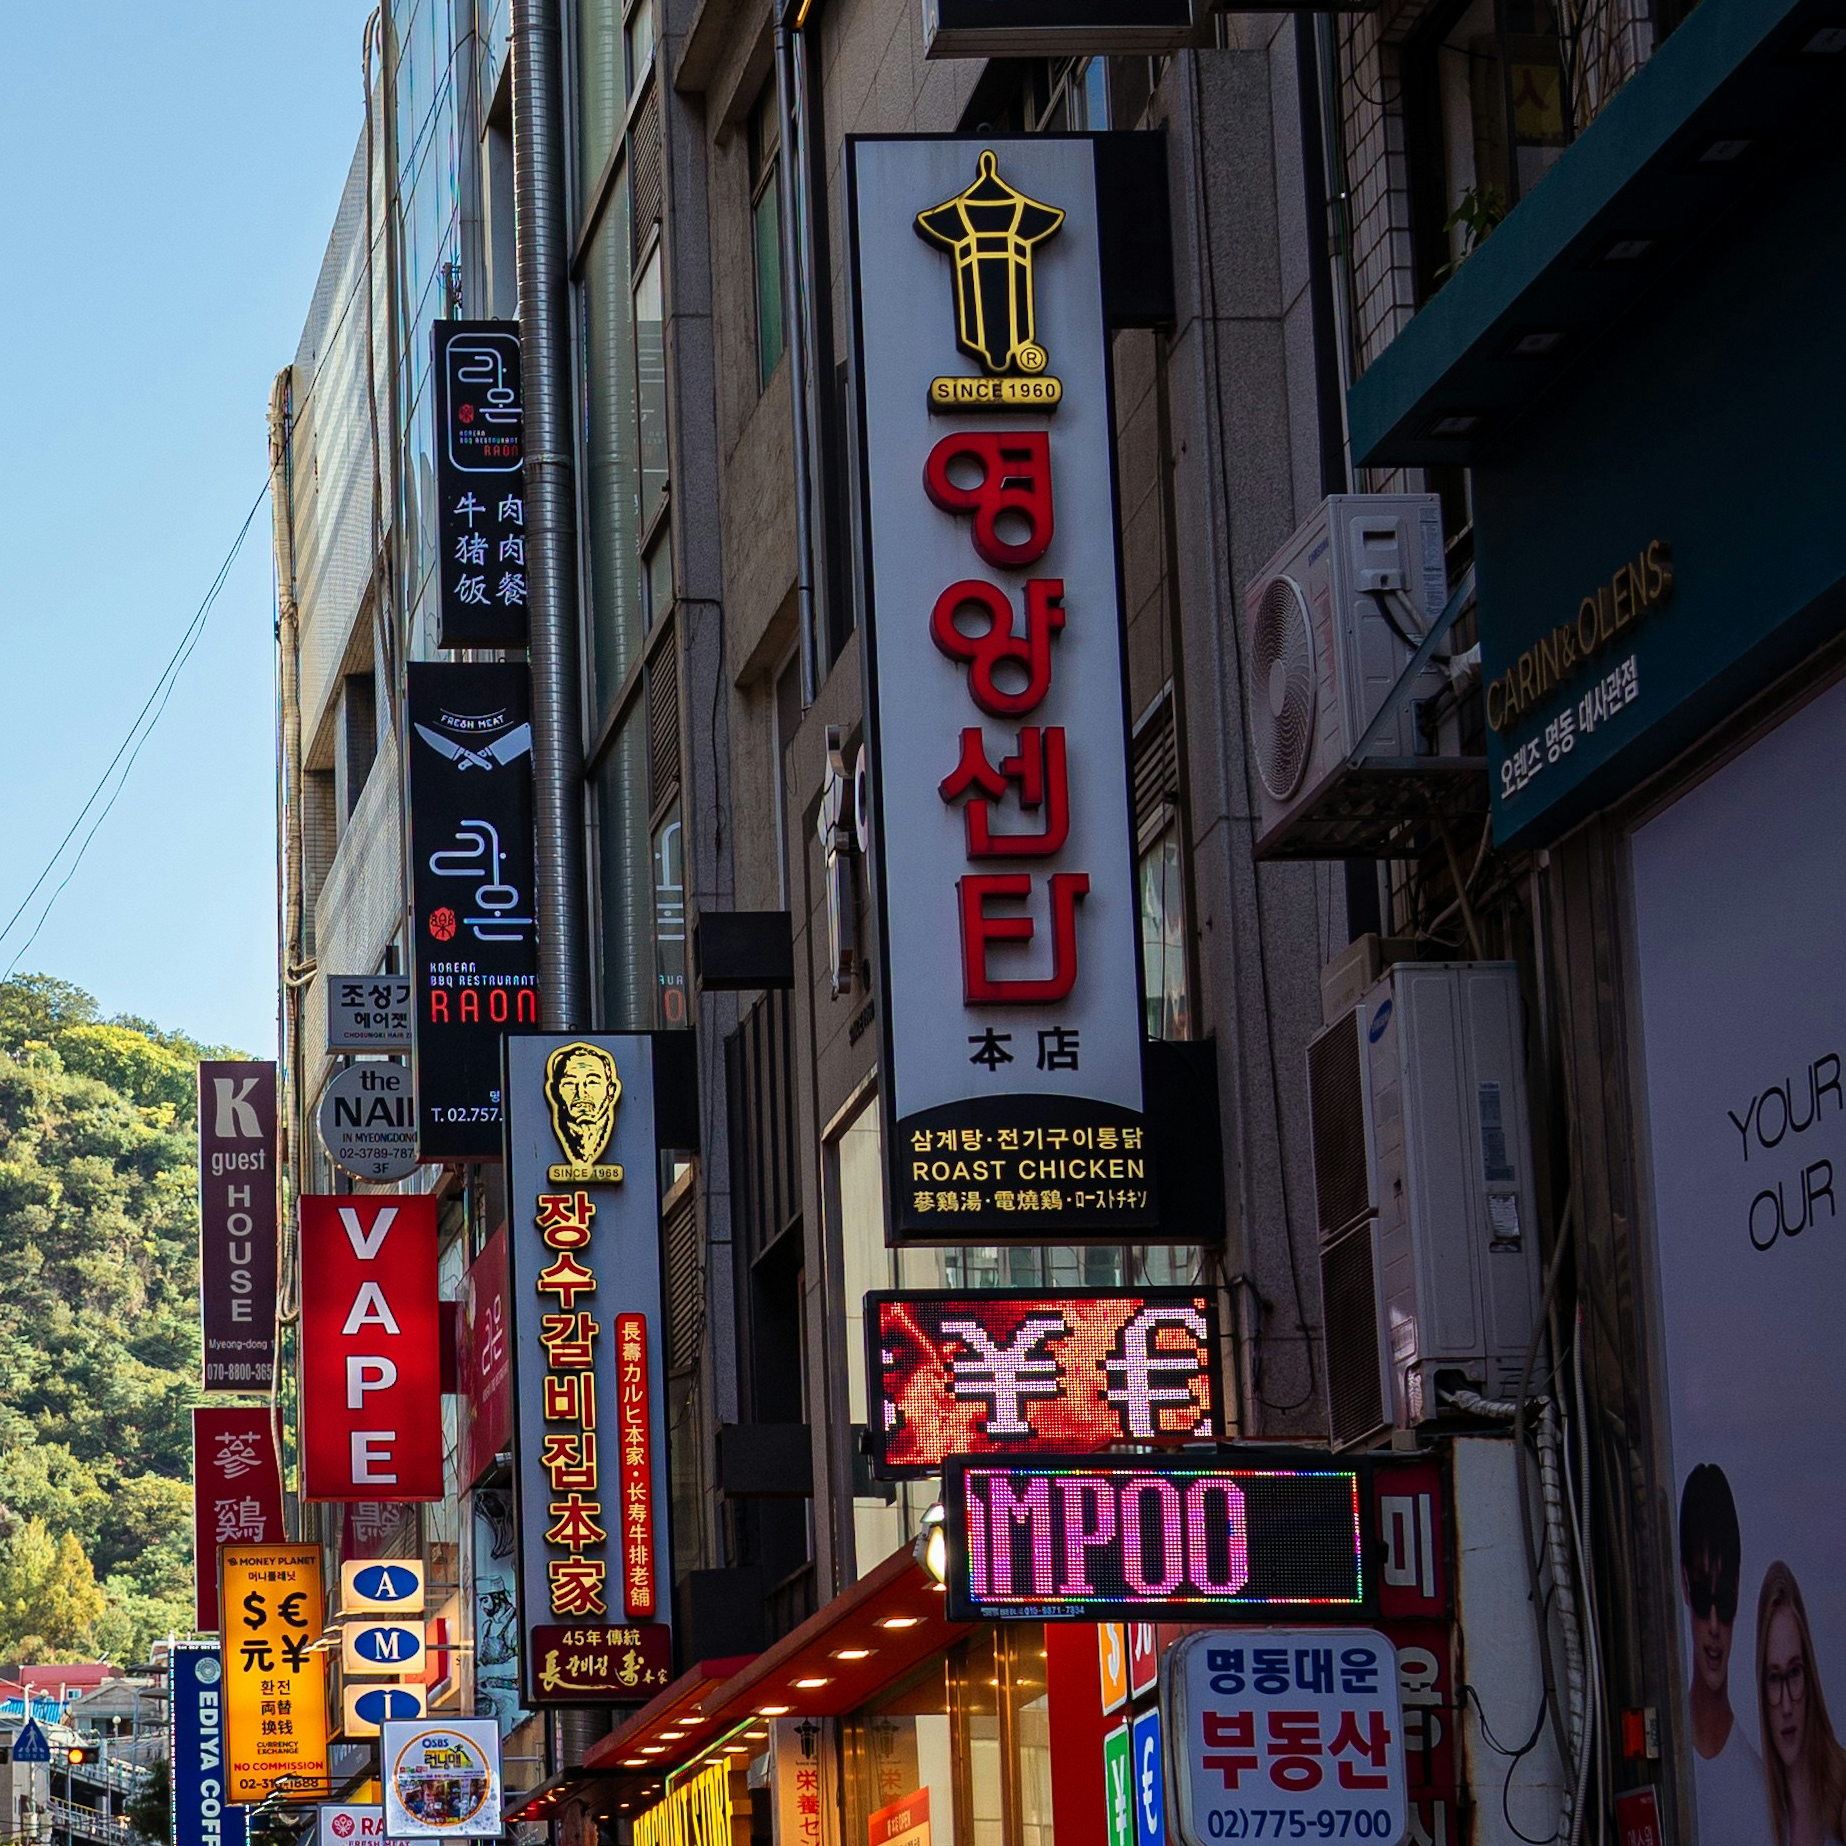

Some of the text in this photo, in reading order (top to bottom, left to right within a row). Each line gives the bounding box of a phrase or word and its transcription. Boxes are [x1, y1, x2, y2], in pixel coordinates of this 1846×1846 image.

[937, 382, 1059, 399] SINCE 1960
[478, 714, 505, 730] MEAT
[1500, 655, 1639, 800] 오렌즈 명동 대사관점
[430, 962, 477, 974] KOREAN
[430, 975, 535, 987] BBQ RESTAURANT
[430, 988, 537, 1025] RAON
[969, 1026, 1082, 1073] 本店
[360, 1070, 400, 1091] the
[213, 1077, 264, 1139] K
[1728, 1053, 1844, 1162] YOUR
[342, 1133, 353, 1143] IN
[212, 1150, 266, 1180] guest
[372, 1162, 390, 1174] 3F
[553, 1167, 621, 1179] SINCE 1968
[912, 1158, 1145, 1180] ROAST CHICKEN
[1749, 1159, 1836, 1252] OUR
[227, 1185, 254, 1323] HOUSE
[208, 1338, 268, 1353] Myeong-dong
[338, 1207, 401, 1485] VAPE
[536, 1190, 607, 1620] 장수갈비집本家
[239, 1555, 316, 1566] MONEY PLANET
[561, 1629, 602, 1649] 45年
[1208, 1647, 1378, 1694] 명동대운
[260, 1680, 291, 1695] 환전
[199, 1691, 219, 1772] EDIYA
[1202, 1710, 1391, 1791] 부동산
[234, 1761, 324, 1771] NO COMMISSION
[1207, 1808, 1391, 1839] 02)775-9700
